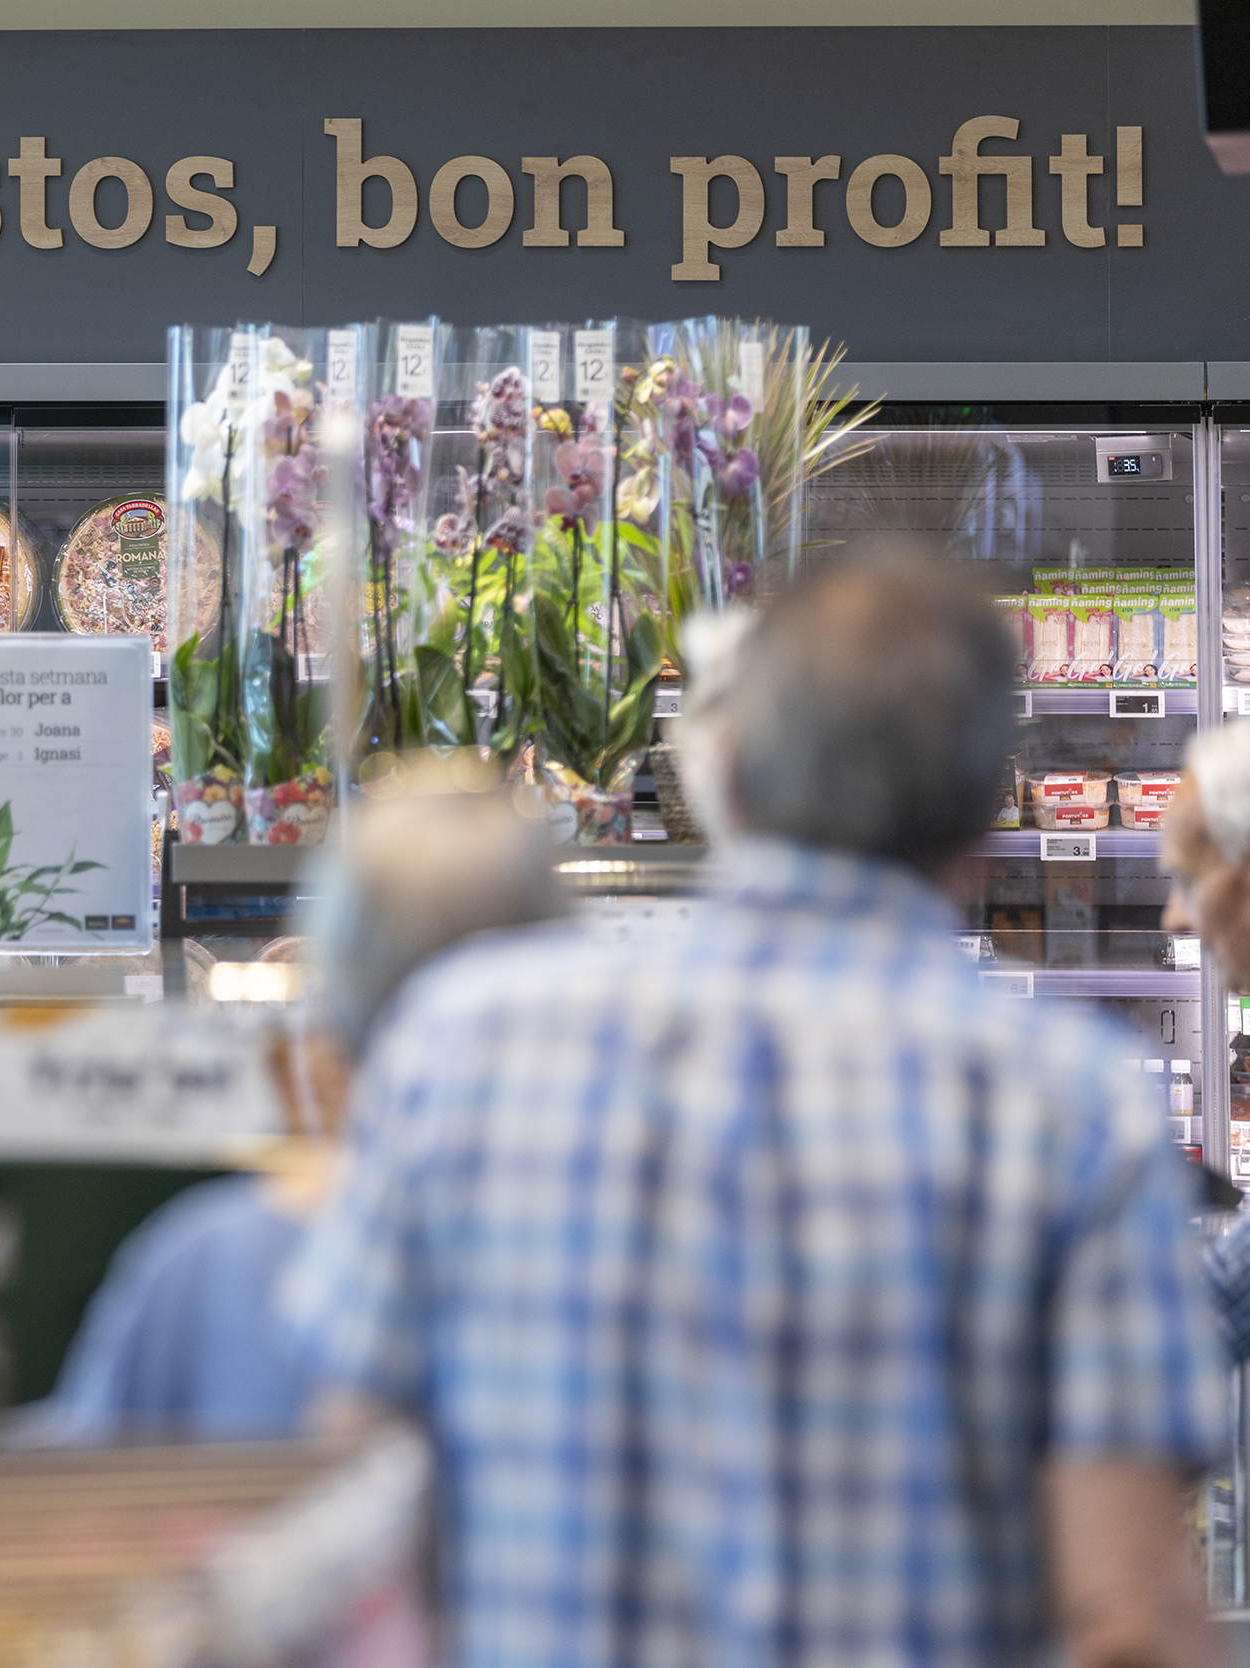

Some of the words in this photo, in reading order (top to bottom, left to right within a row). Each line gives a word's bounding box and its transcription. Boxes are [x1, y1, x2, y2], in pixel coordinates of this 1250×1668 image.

[323, 118, 626, 249] bon
[669, 115, 1145, 281] profit!
[115, 550, 164, 563] ROMANA
[1163, 583, 1196, 594] ñamin
[1160, 596, 1196, 607] ñamin
[30, 670, 108, 686] setmana
[27, 691, 57, 710] per
[61, 692, 72, 706] a
[10, 727, 24, 738] 30
[35, 723, 81, 737] Joana
[35, 746, 81, 764] Ignasi
